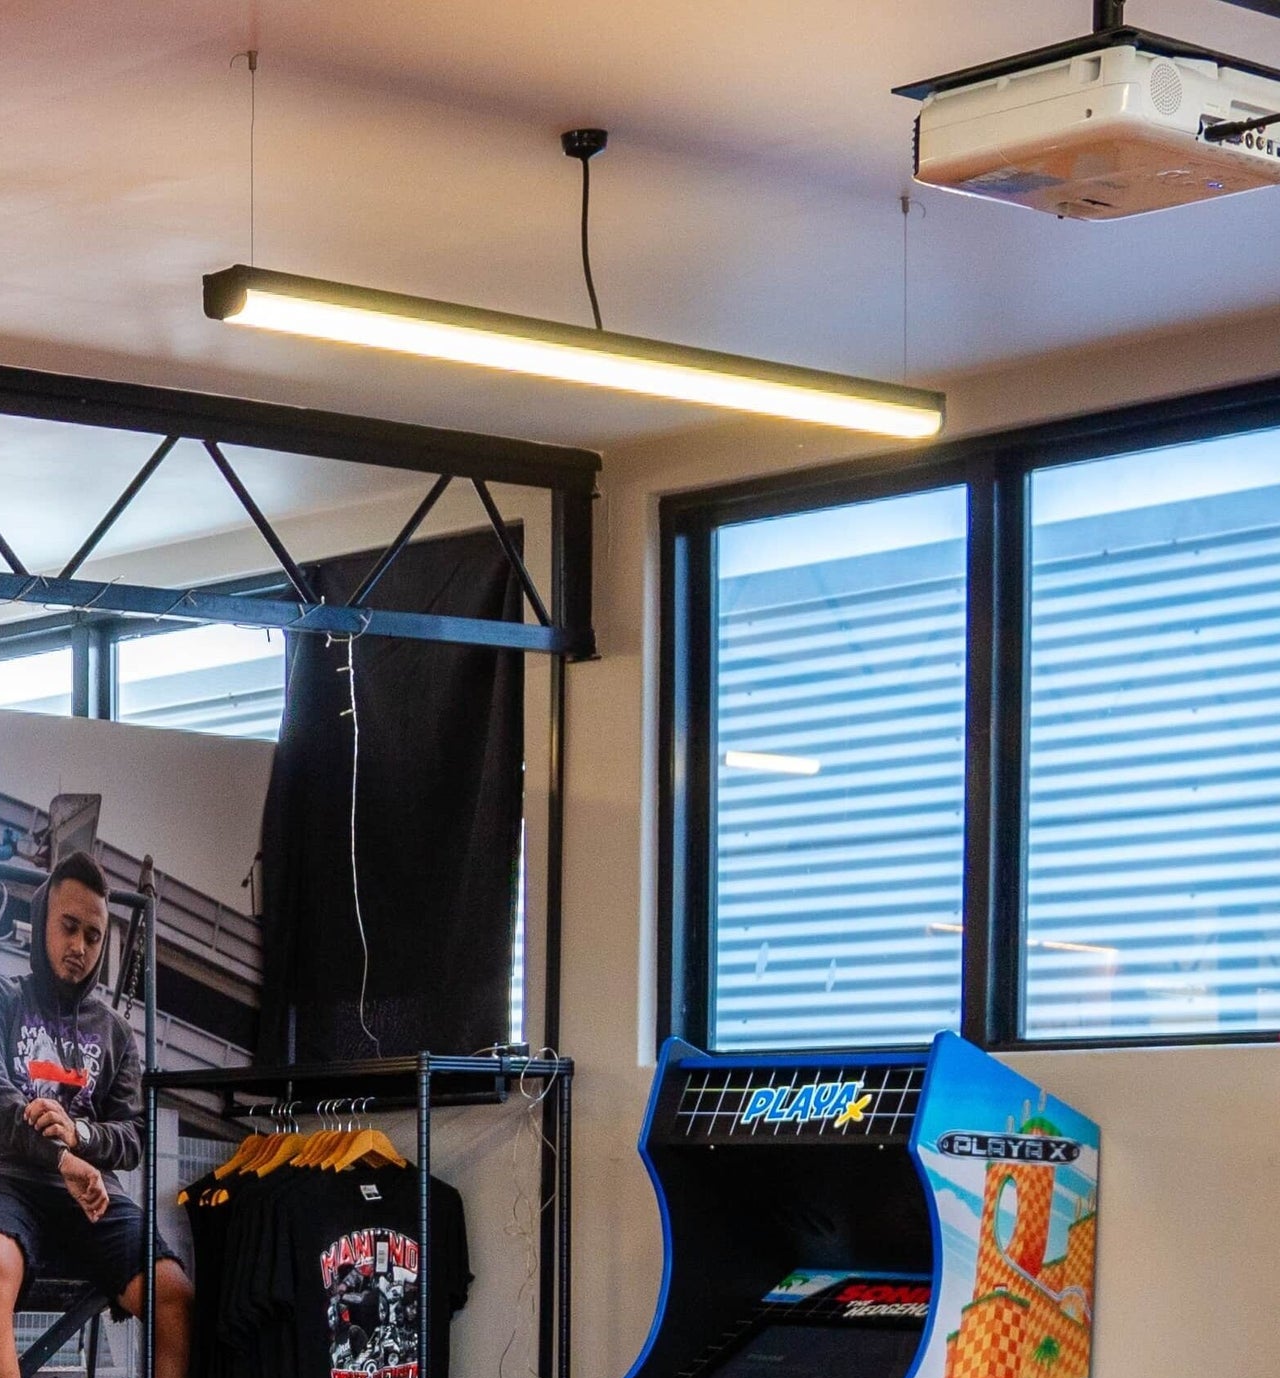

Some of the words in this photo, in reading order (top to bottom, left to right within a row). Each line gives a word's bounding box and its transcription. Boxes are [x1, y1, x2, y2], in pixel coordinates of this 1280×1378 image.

[740, 1081, 860, 1125] PLAYA
[953, 1135, 1044, 1159] PLAYA
[1048, 1142, 1068, 1161] X
[320, 1228, 418, 1289] MANND
